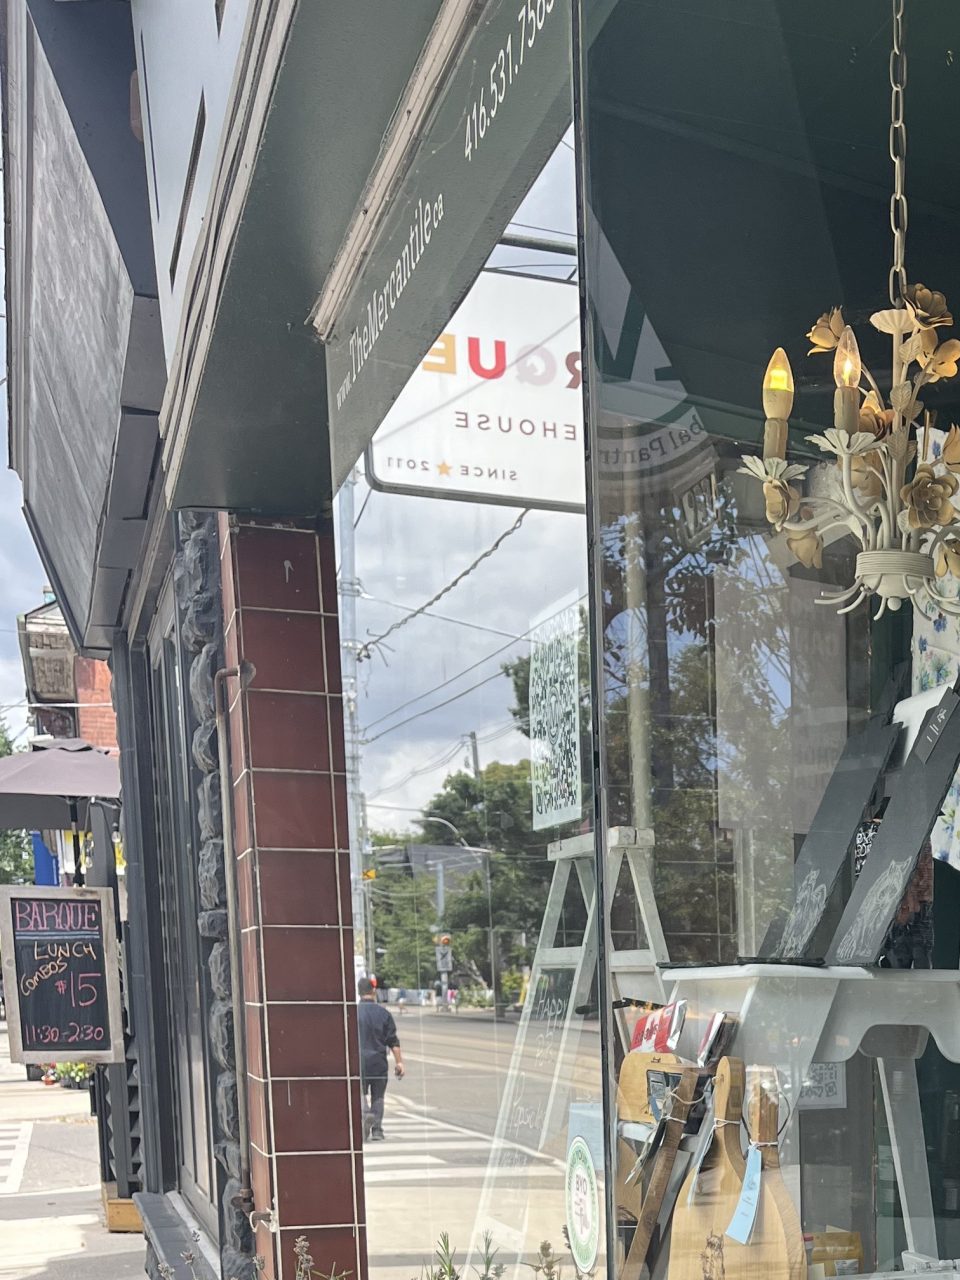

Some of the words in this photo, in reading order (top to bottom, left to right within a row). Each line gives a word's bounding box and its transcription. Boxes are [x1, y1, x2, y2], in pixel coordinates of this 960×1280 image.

[465, 0, 554, 161] 416.531.75
[15, 901, 99, 931] BARQUE
[34, 941, 97, 960] LUNCH
[20, 957, 68, 996] COMBOS
